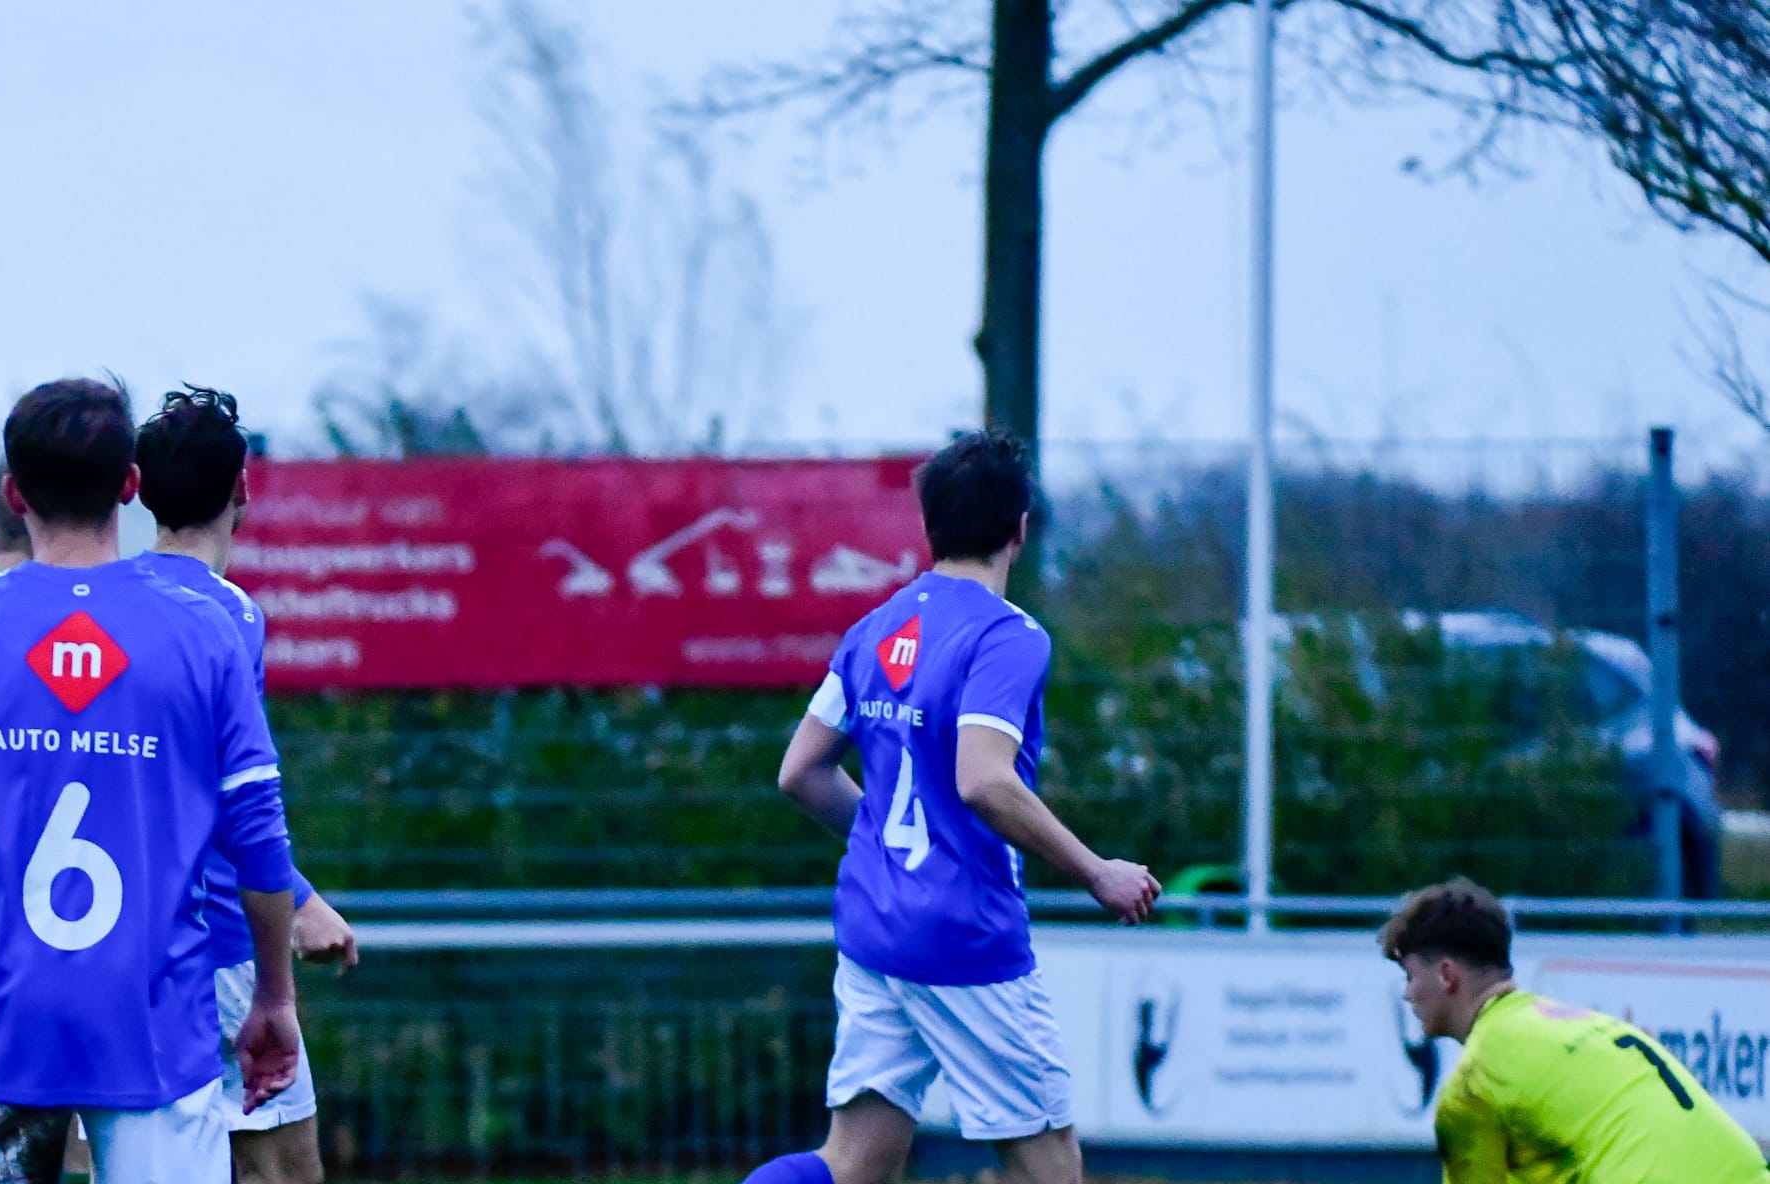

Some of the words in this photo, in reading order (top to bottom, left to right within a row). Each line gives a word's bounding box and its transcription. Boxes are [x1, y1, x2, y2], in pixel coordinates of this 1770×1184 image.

[71, 730, 159, 758] MELSE
[883, 746, 930, 872] 4
[22, 781, 123, 951] 6
[1614, 1035, 1695, 1111] 1
